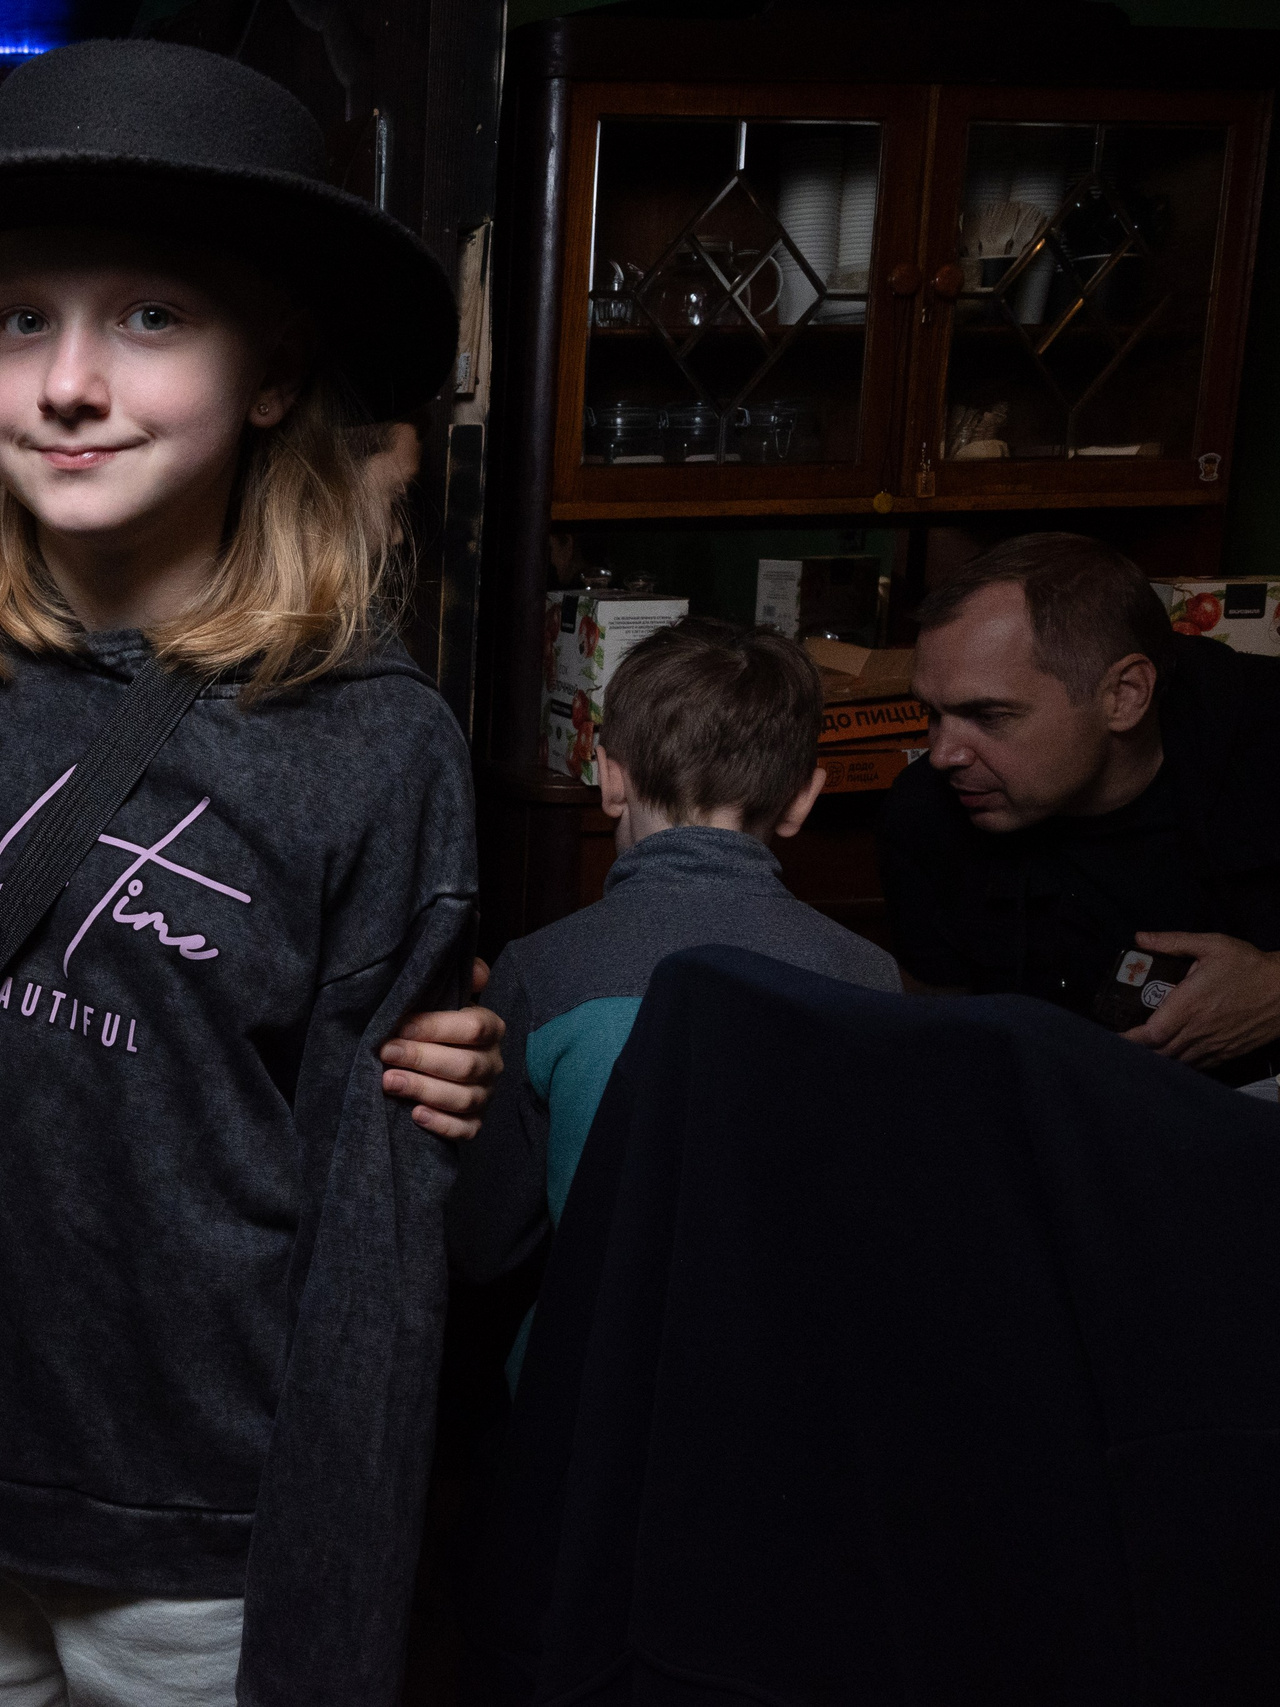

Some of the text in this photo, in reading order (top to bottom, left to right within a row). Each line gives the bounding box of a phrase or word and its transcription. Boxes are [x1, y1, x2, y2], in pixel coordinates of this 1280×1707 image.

[822, 713, 853, 733] ДО
[848, 762, 875, 773] ДОДО
[847, 771, 879, 782] ПИЦЦА
[64, 796, 252, 979] Time
